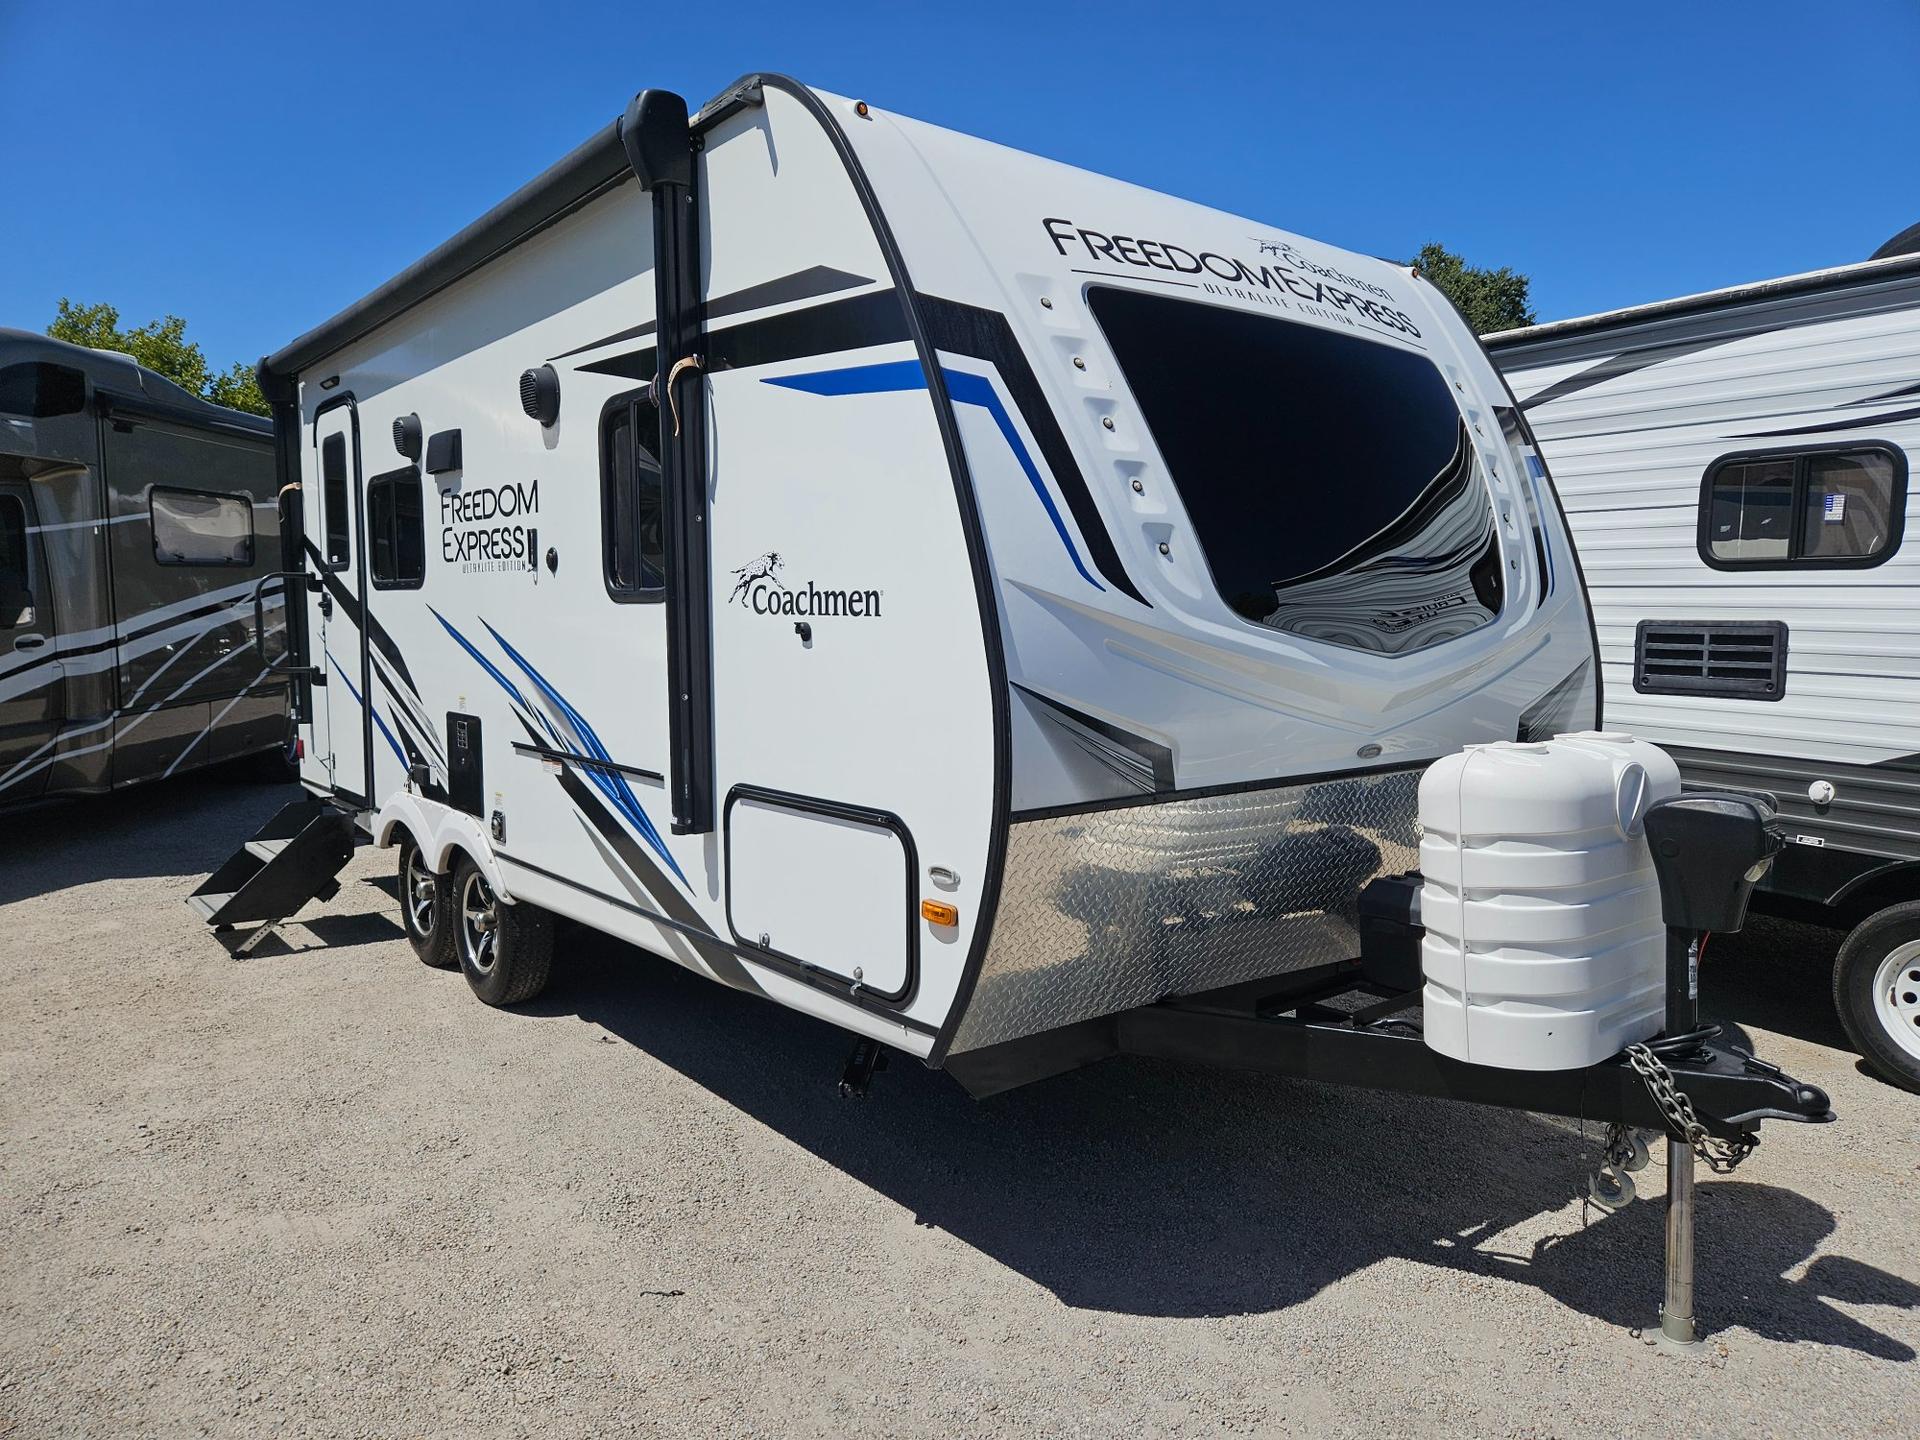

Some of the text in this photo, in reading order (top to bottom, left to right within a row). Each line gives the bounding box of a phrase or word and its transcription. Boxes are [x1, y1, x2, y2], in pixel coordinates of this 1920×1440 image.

[1283, 252, 1396, 303] Coachmen
[1203, 282, 1356, 327] ULTRALITE EDITION
[441, 479, 539, 525] FREEDOM
[442, 525, 525, 563] EXPRESS
[462, 560, 526, 574] ULTRALITE EDITION
[752, 580, 882, 617] Coachmen
